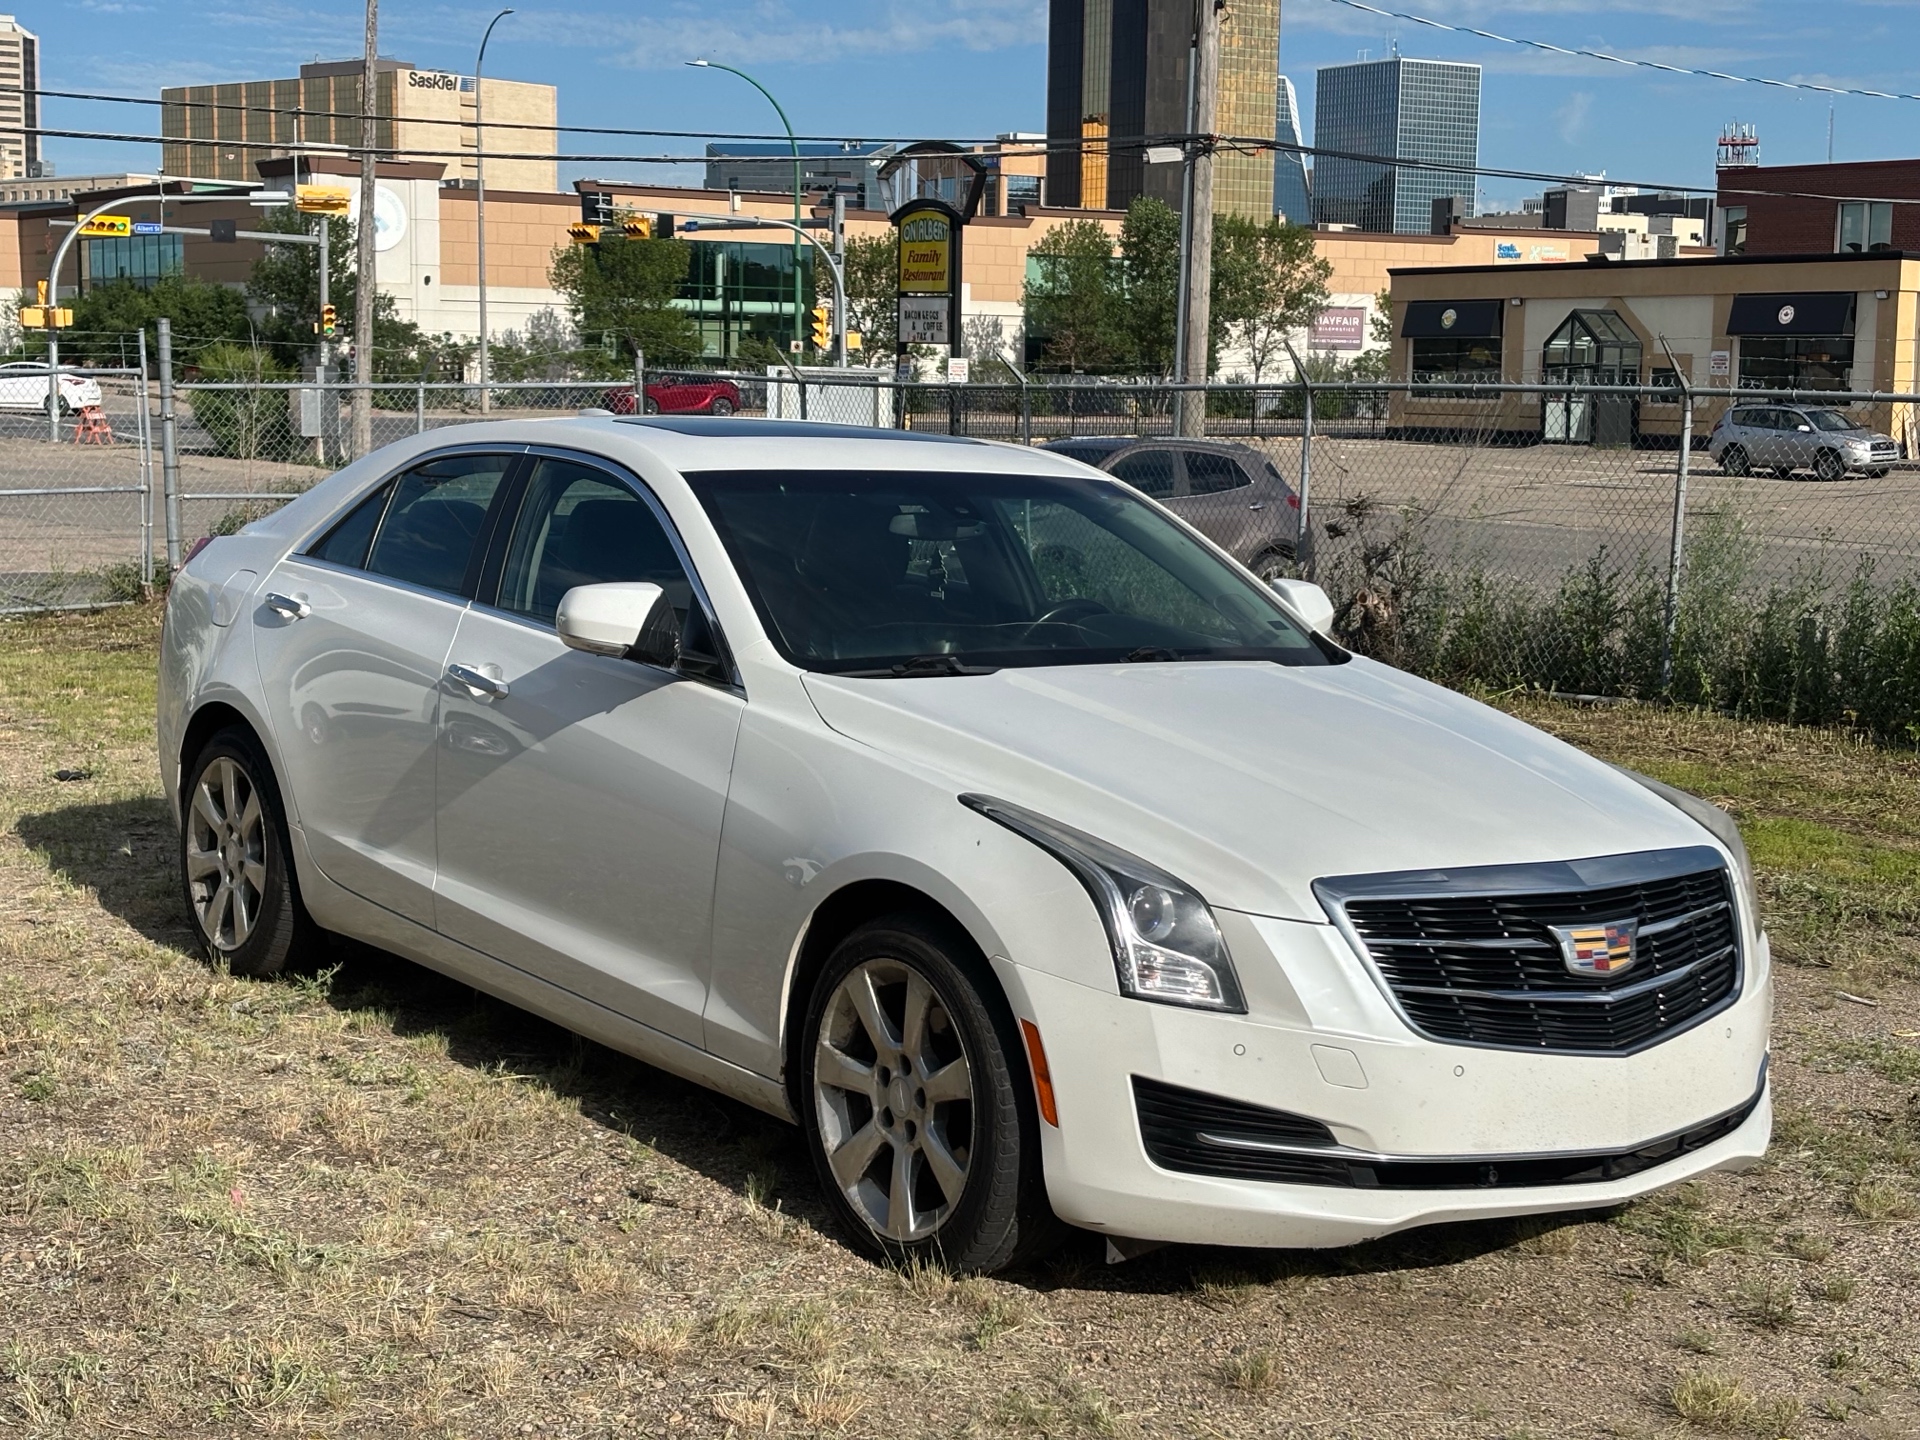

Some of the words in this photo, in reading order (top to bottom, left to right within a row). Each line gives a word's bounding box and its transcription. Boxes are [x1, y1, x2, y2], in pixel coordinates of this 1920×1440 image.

[408, 71, 458, 91] SaskTel
[903, 222, 918, 243] ON
[918, 218, 948, 242] ALBERT
[907, 250, 941, 266] Family
[902, 268, 945, 281] Restaurant
[911, 321, 916, 330] &
[923, 321, 943, 331] COFFEE
